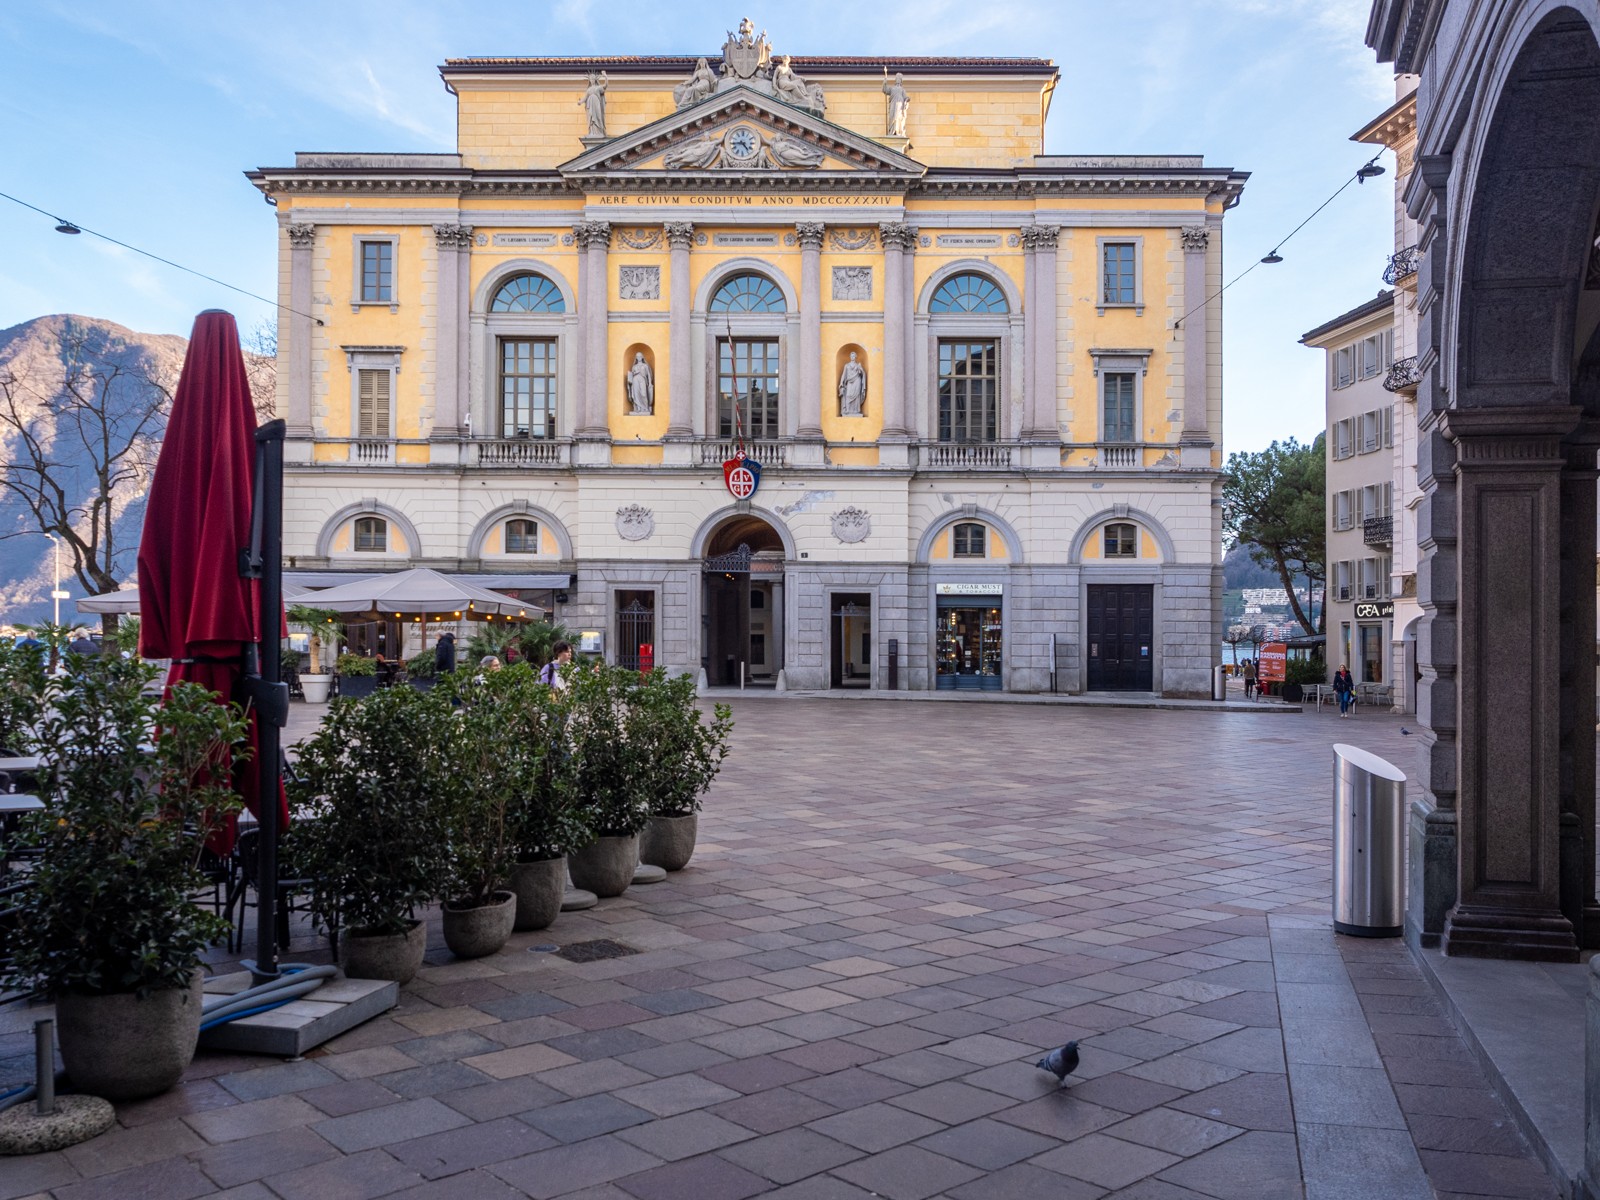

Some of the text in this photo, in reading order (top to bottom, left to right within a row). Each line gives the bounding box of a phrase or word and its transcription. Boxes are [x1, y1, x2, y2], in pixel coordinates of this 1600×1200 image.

[600, 196, 892, 205] AERE CIVIVM CONDITVM ANNO MDCCCXXXXIV
